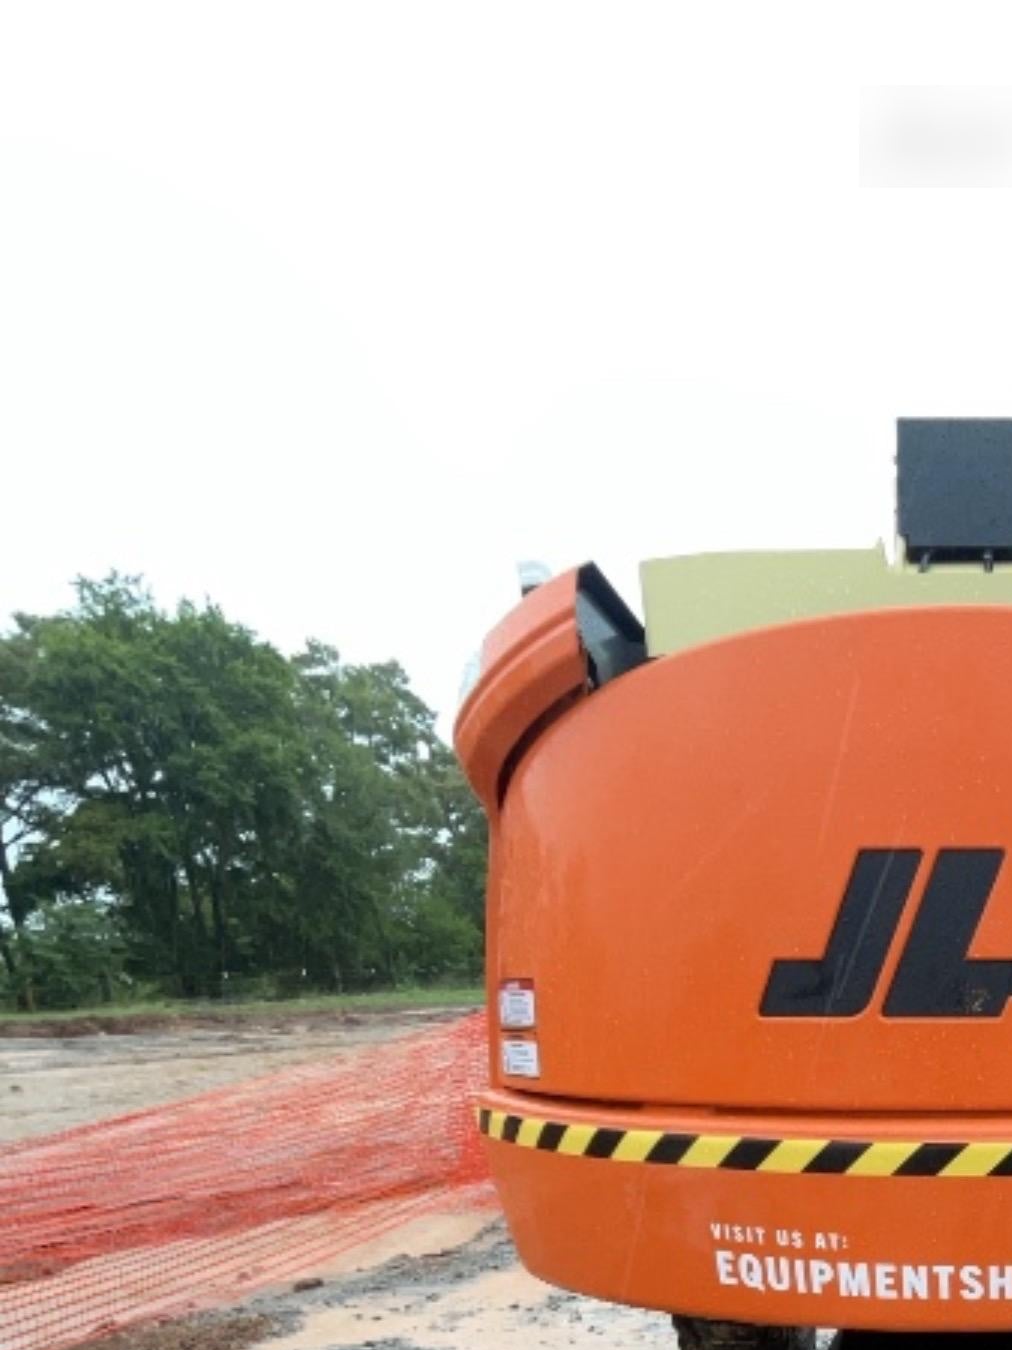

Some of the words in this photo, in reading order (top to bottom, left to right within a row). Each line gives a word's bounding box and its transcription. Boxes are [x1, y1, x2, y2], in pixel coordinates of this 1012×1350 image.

[710, 1222, 766, 1245] VISIT
[775, 1228, 804, 1248] US
[814, 1231, 849, 1251] AT:
